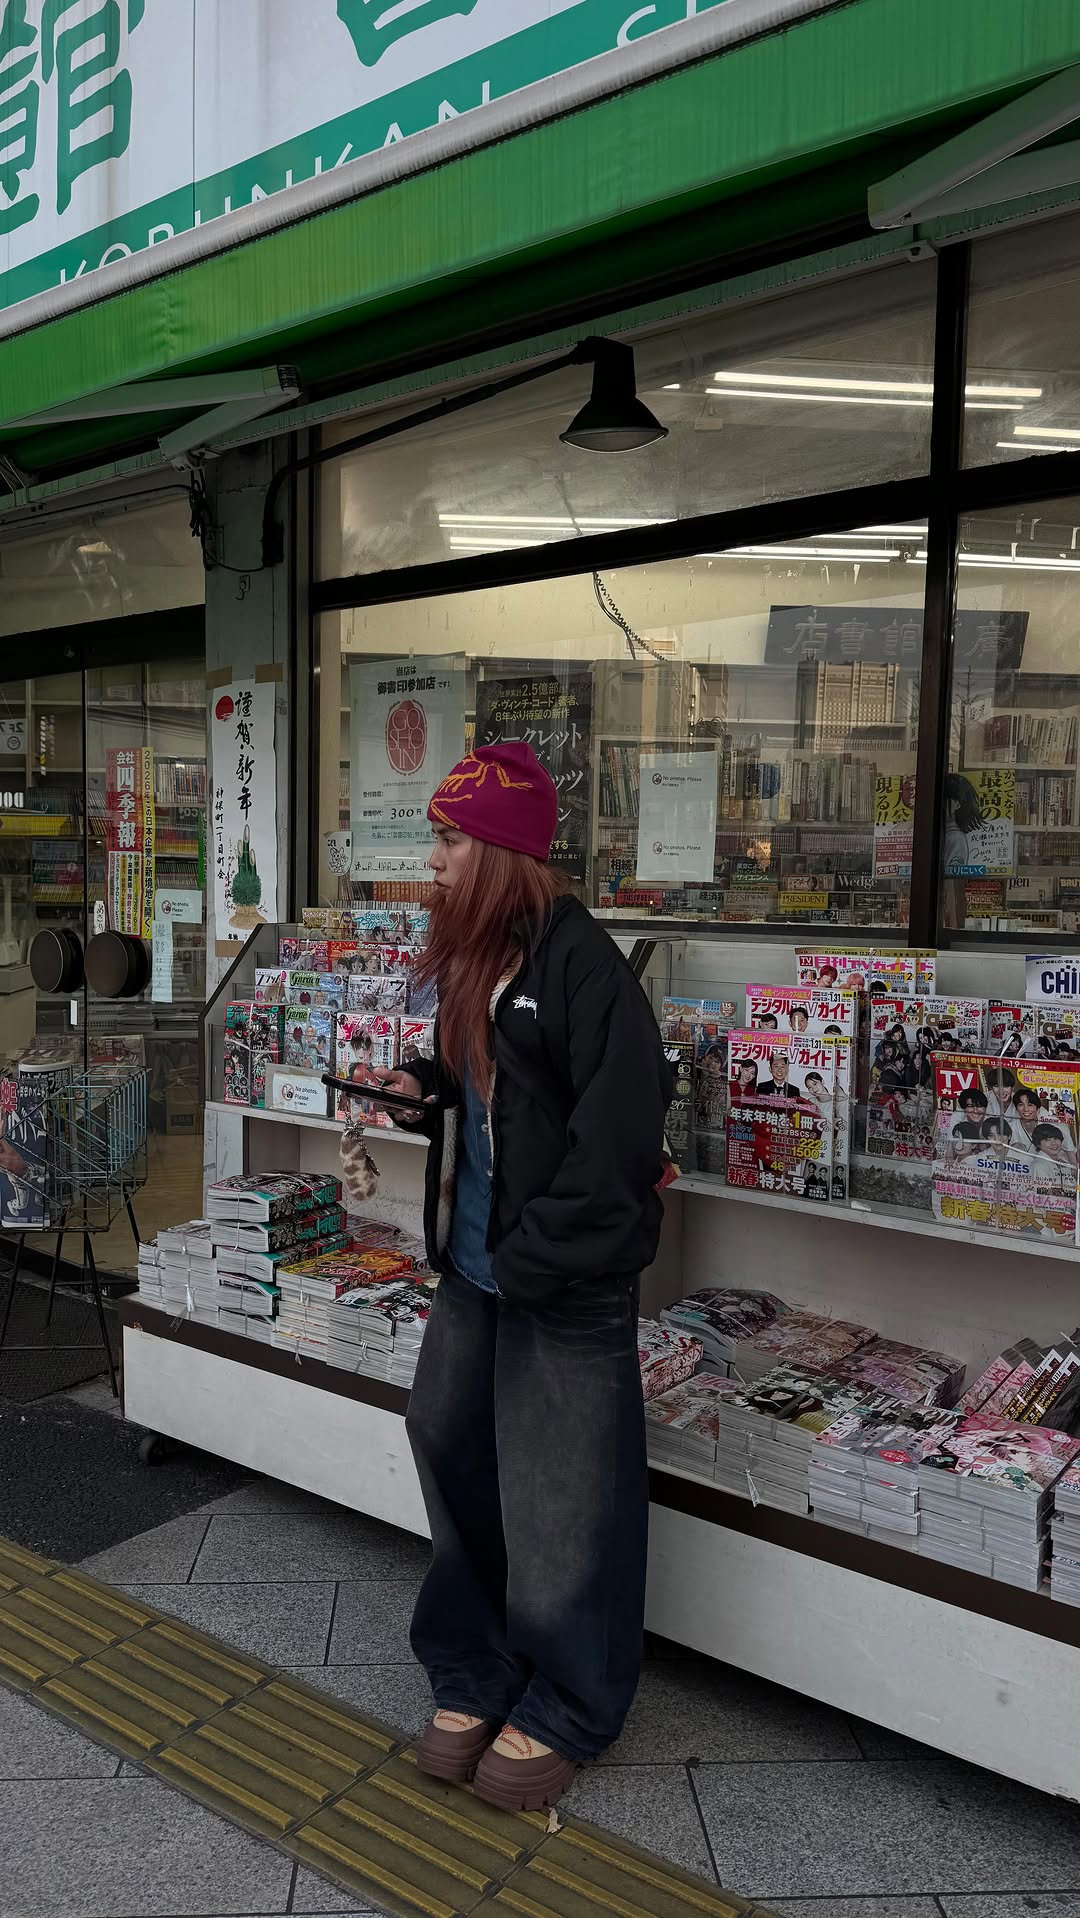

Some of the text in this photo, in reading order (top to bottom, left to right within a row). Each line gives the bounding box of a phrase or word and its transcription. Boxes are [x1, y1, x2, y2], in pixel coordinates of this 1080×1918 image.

[395, 665, 417, 677] 当店は
[392, 708, 421, 731] GO
[389, 728, 425, 750] SHO
[484, 722, 582, 749] シークレット
[116, 751, 135, 764] 会社
[875, 776, 892, 827] 現る!!
[979, 771, 1003, 821] 最高の
[1003, 770, 1015, 820] かつてなく
[116, 766, 137, 848] 四季報
[610, 859, 633, 871] 相続
[838, 874, 878, 889] Wedge
[1009, 876, 1031, 889] pen
[783, 895, 825, 903] PRESIDENT
[814, 956, 913, 972] 月刊TVガイド
[1041, 970, 1080, 994] CHI
[751, 998, 851, 1020] デジタルTVガイド
[731, 1042, 832, 1067] デジタルTVガイド
[939, 1069, 974, 1090] TV
[730, 1106, 829, 1132] 年末年始を、1冊で。
[977, 1158, 1030, 1174] SixTONES
[727, 1166, 807, 1195] 新春特大号
[940, 1195, 1070, 1235] 新春特大号
